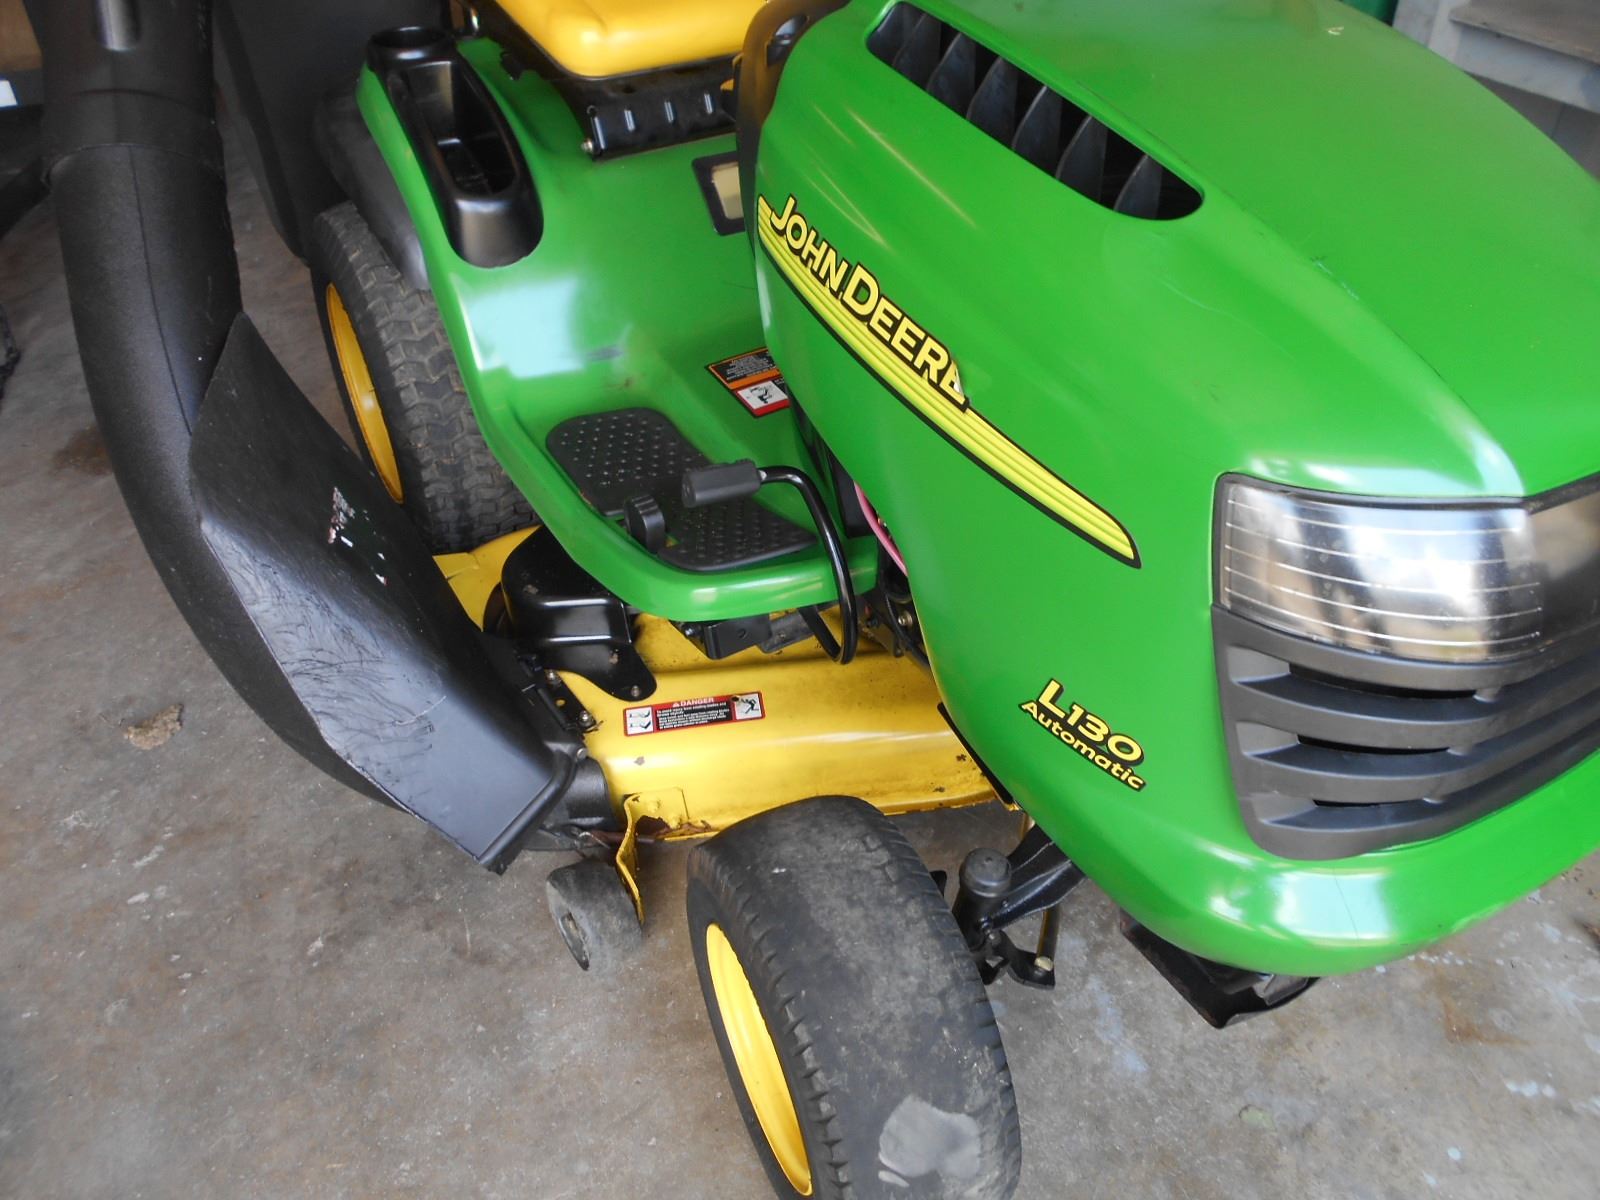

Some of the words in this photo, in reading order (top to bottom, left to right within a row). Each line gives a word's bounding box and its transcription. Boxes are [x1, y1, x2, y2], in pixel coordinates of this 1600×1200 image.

[770, 194, 852, 298] JOHN
[680, 697, 714, 707] DANGER
[1019, 700, 1145, 791] Automatic
[1037, 679, 1143, 764] L130
